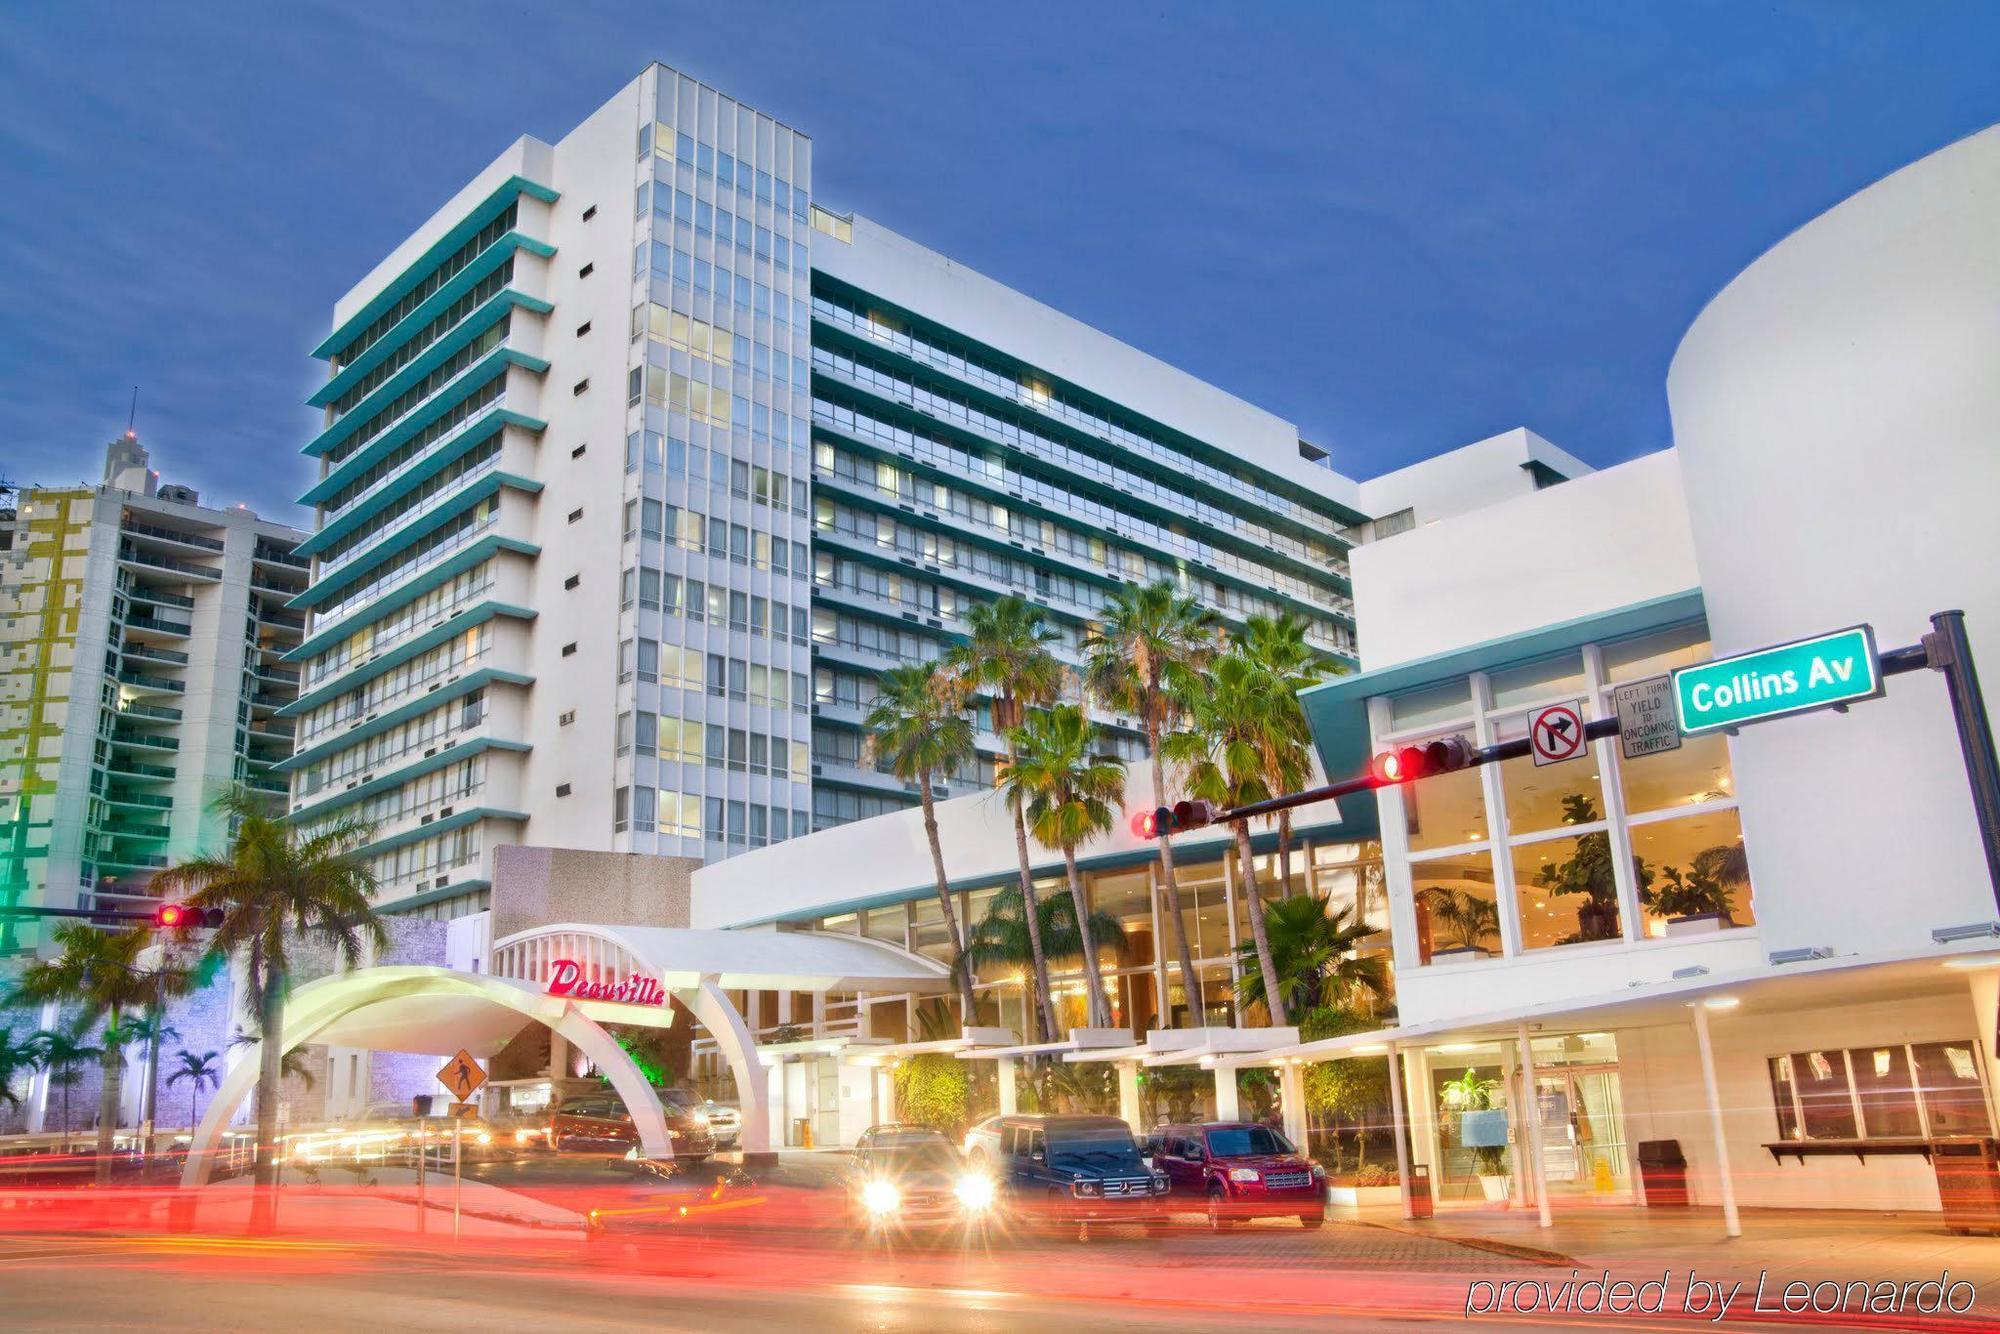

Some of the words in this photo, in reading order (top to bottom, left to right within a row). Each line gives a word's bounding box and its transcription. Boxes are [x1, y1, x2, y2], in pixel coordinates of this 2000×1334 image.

[1619, 688, 1640, 701] LEFT
[1646, 682, 1668, 695] TURN
[1692, 669, 1799, 712] Collins
[1808, 656, 1853, 689] Av
[1630, 697, 1661, 713] YIELD
[1643, 713, 1653, 723] TO
[1624, 719, 1675, 740] ONCOMING
[1631, 735, 1671, 753] TRAFFIC
[548, 959, 665, 1005] Deauville
